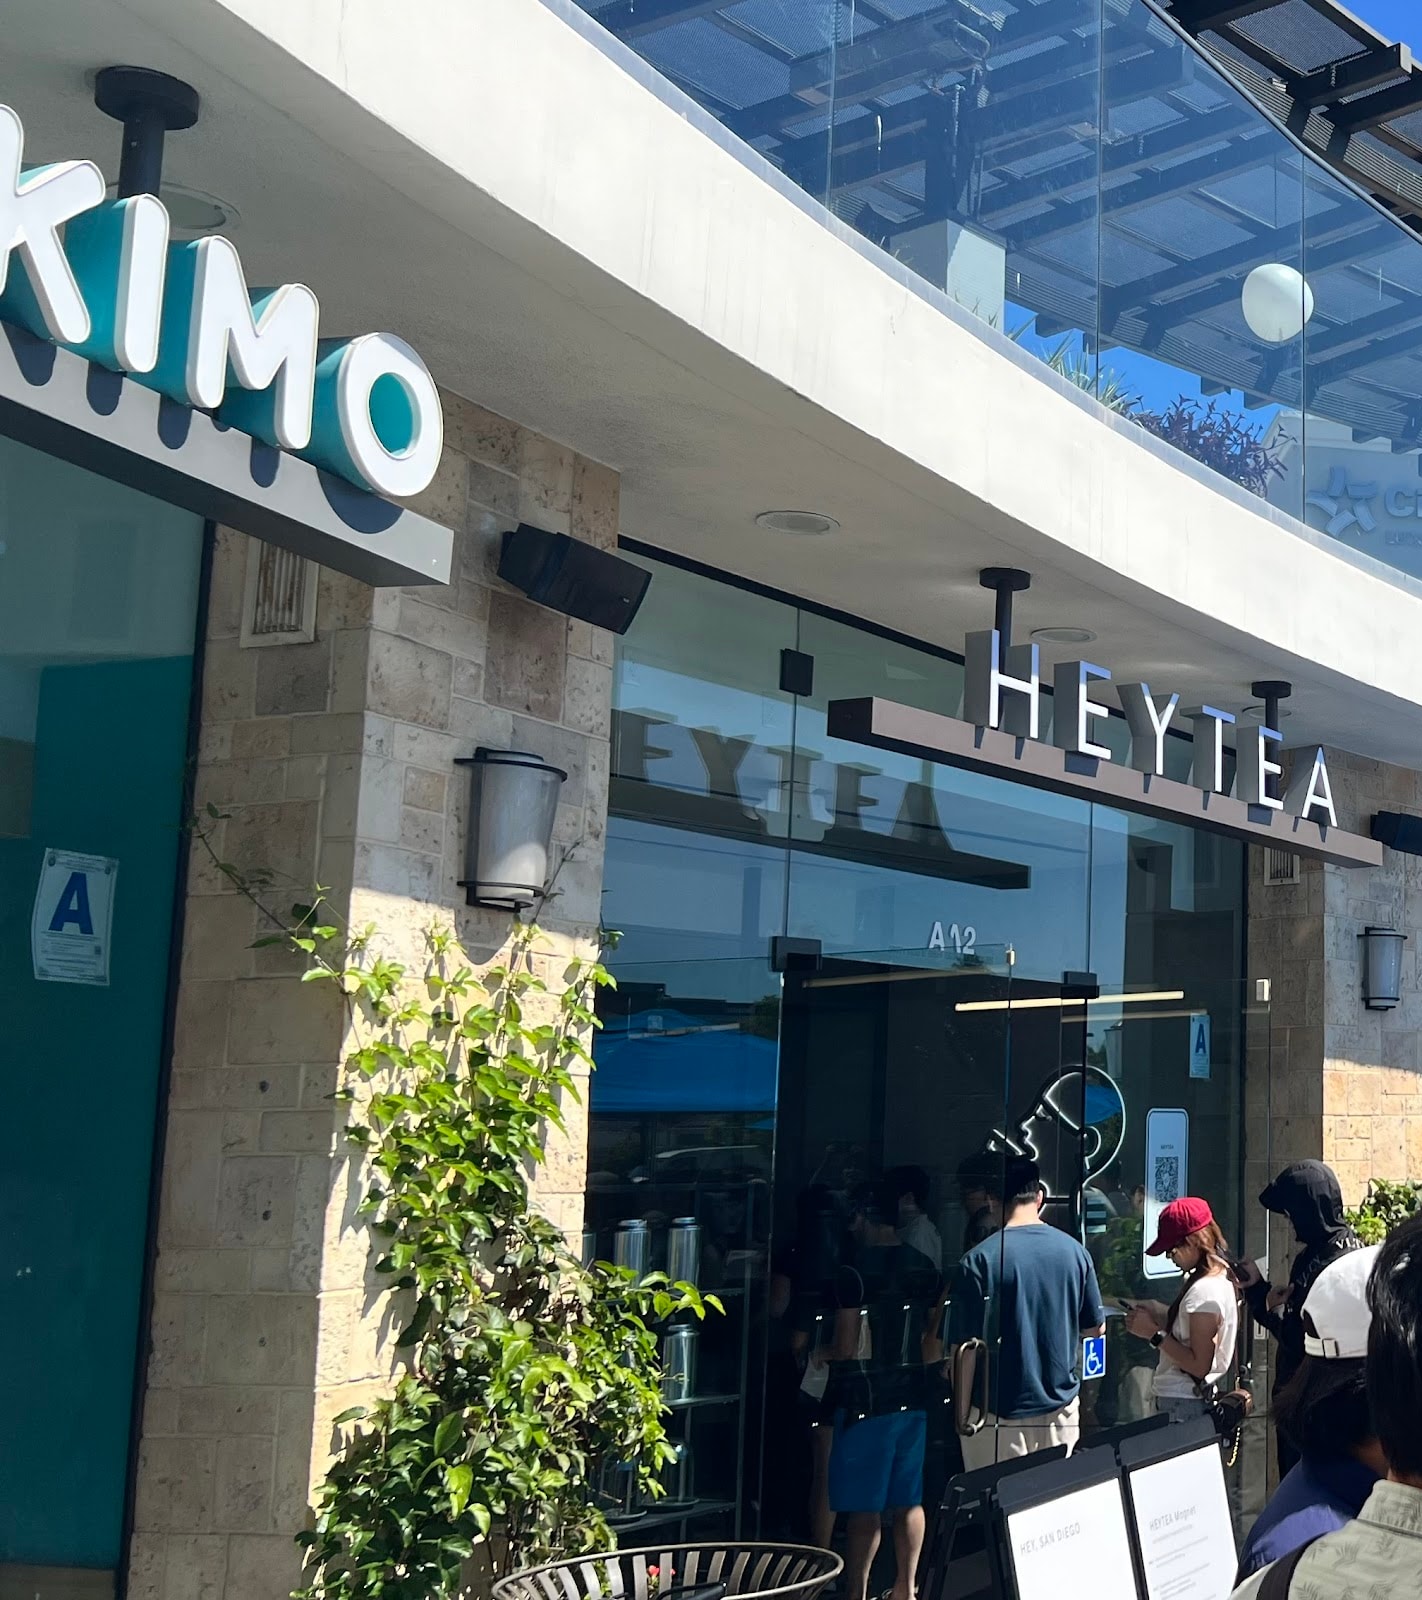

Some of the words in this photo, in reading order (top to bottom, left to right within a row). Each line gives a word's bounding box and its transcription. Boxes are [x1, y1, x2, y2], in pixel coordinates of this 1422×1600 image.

[0, 104, 444, 498] KIMO
[985, 629, 1338, 828] HEYTEA
[48, 871, 94, 935] A
[1195, 1023, 1206, 1054] A
[1056, 1521, 1081, 1542] DIEGO
